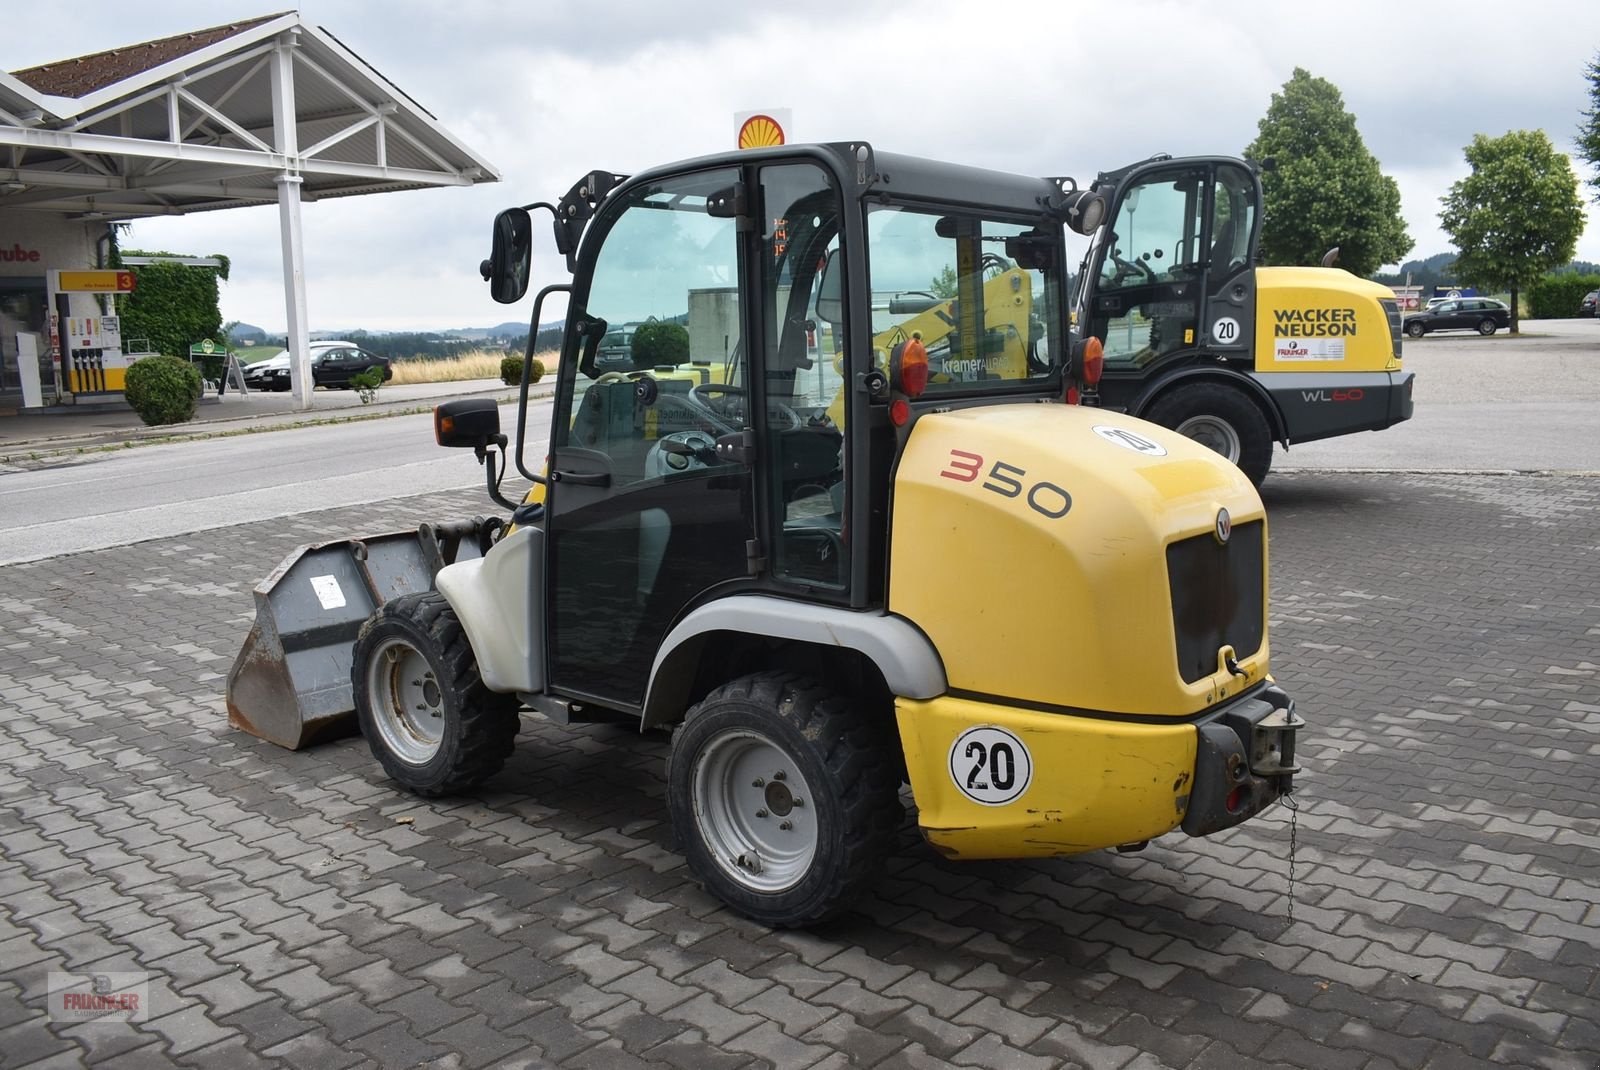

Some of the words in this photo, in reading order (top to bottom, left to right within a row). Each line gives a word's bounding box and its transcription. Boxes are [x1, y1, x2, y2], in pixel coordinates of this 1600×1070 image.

[0, 243, 40, 262] ube
[121, 275, 132, 288] 3
[1273, 308, 1356, 322] WACKER
[1218, 322, 1234, 339] 20
[1274, 323, 1357, 337] NEUSON
[1301, 389, 1364, 402] WL60
[1102, 428, 1156, 452] 20
[940, 449, 1073, 520] 350
[965, 741, 1015, 790] 20
